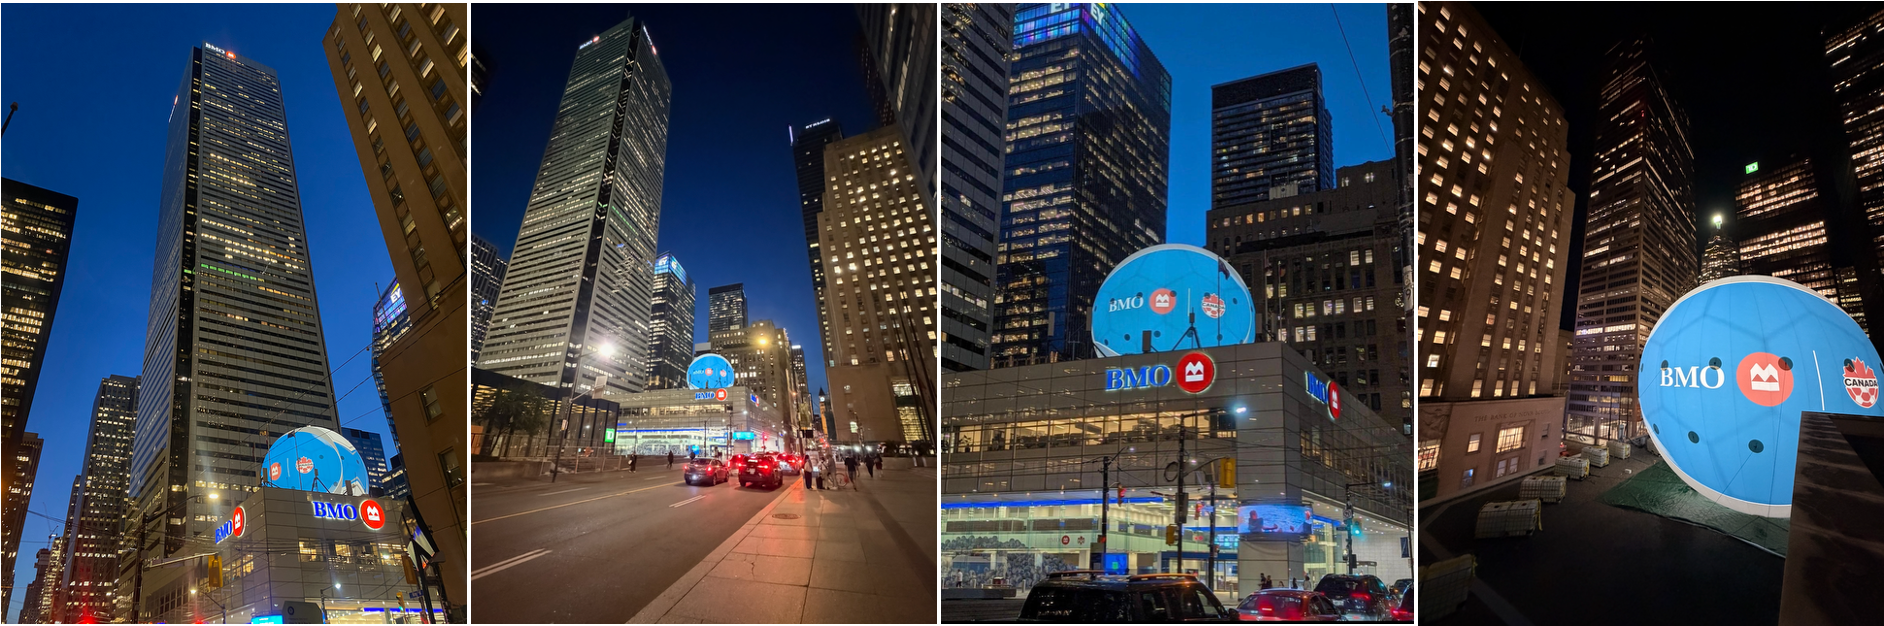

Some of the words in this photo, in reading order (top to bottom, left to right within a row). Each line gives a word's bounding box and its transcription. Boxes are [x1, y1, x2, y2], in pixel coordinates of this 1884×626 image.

[1090, 3, 1105, 25] EY
[205, 42, 226, 54] BMO
[1109, 296, 1144, 312] BMO
[1202, 302, 1226, 310] CANADA
[1105, 364, 1171, 391] BMO
[1305, 371, 1328, 404] BMO
[1660, 366, 1725, 389] BMO
[1844, 378, 1878, 388] CANADA
[695, 391, 716, 401] BMO
[312, 501, 358, 521] BMO
[214, 519, 234, 544] BMO
